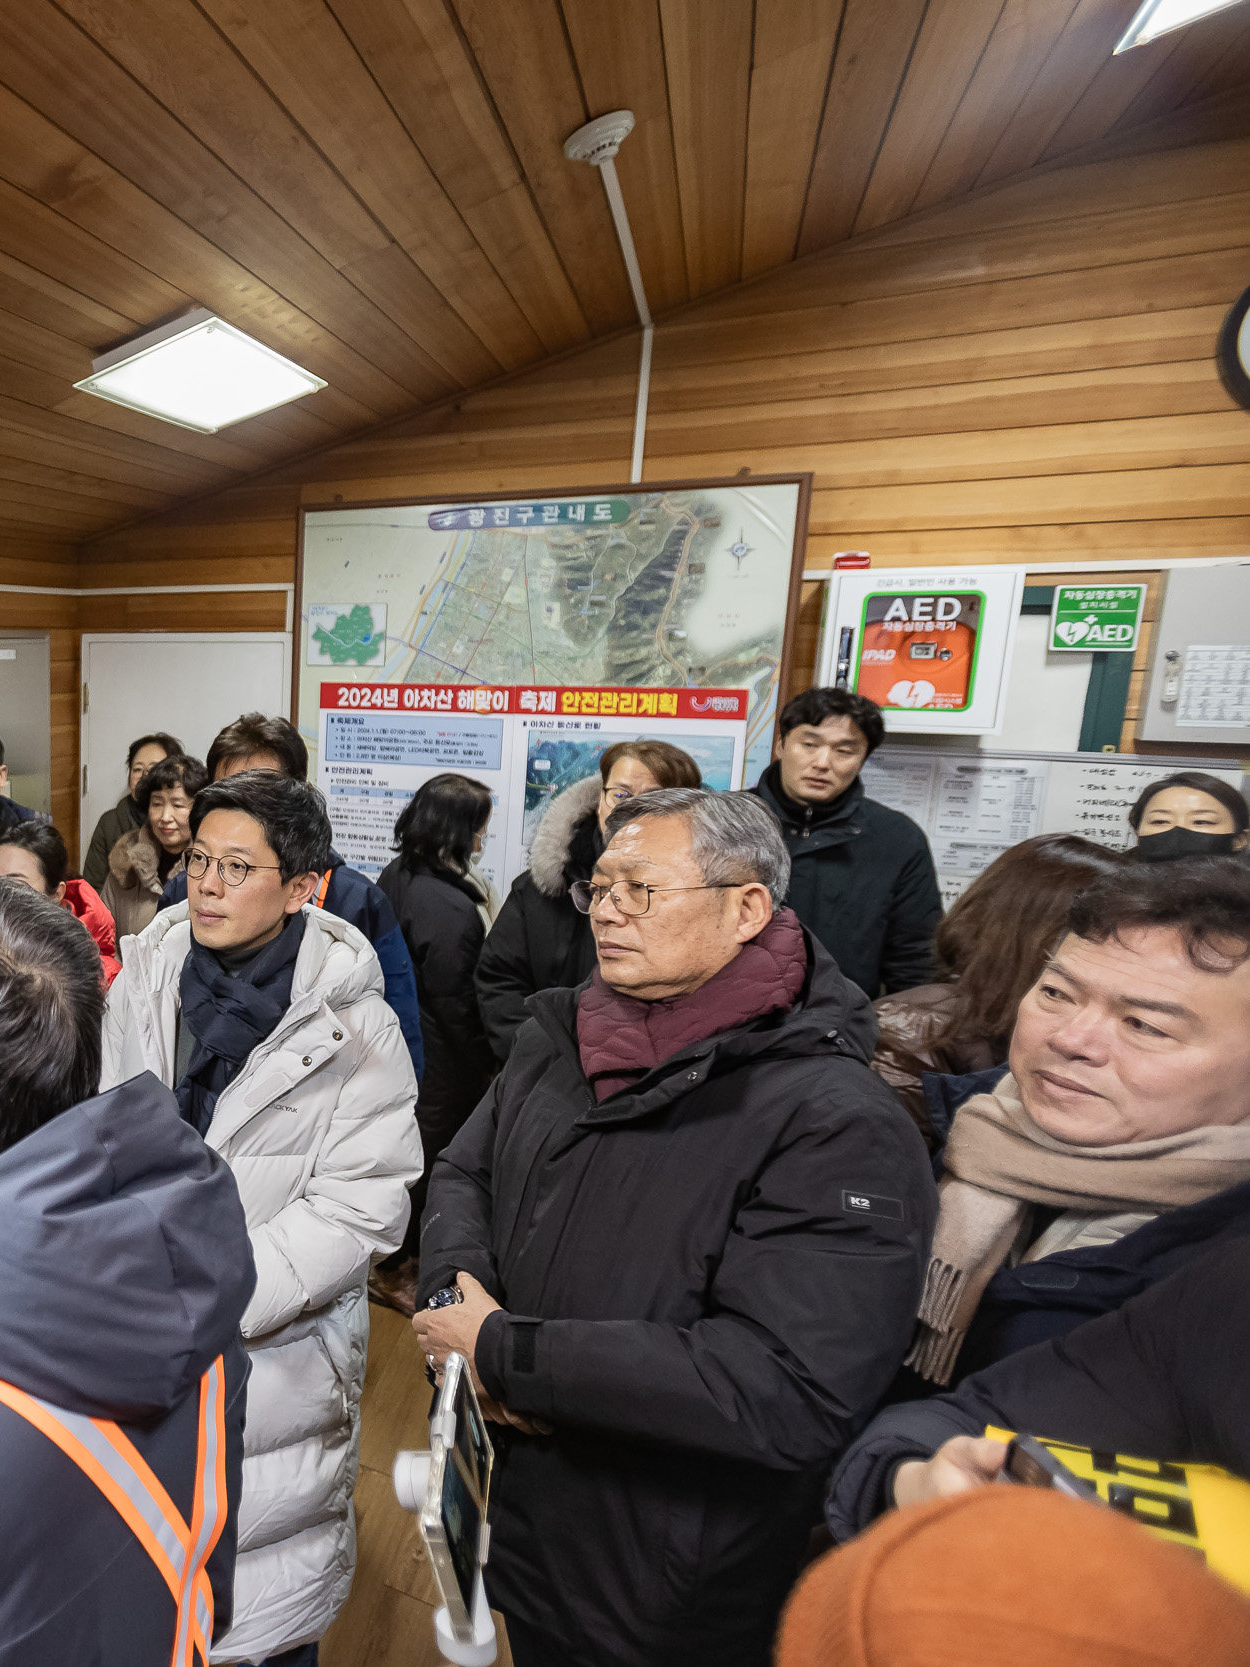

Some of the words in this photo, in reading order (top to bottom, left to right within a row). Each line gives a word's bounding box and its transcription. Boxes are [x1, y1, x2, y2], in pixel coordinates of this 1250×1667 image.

[1062, 589, 1139, 601] 자동심장충격기
[883, 597, 962, 621] AED
[1078, 601, 1119, 609] 설치시설
[882, 621, 957, 632] 자동심장충격기
[1085, 624, 1134, 642] AED
[337, 687, 399, 708] 2024년
[403, 689, 454, 710] 아차산
[457, 689, 510, 712] 해맞이
[518, 690, 557, 713] 축제
[561, 690, 679, 716] 안전관리계획
[530, 720, 555, 728] 아차산
[850, 1196, 870, 1207] K2
